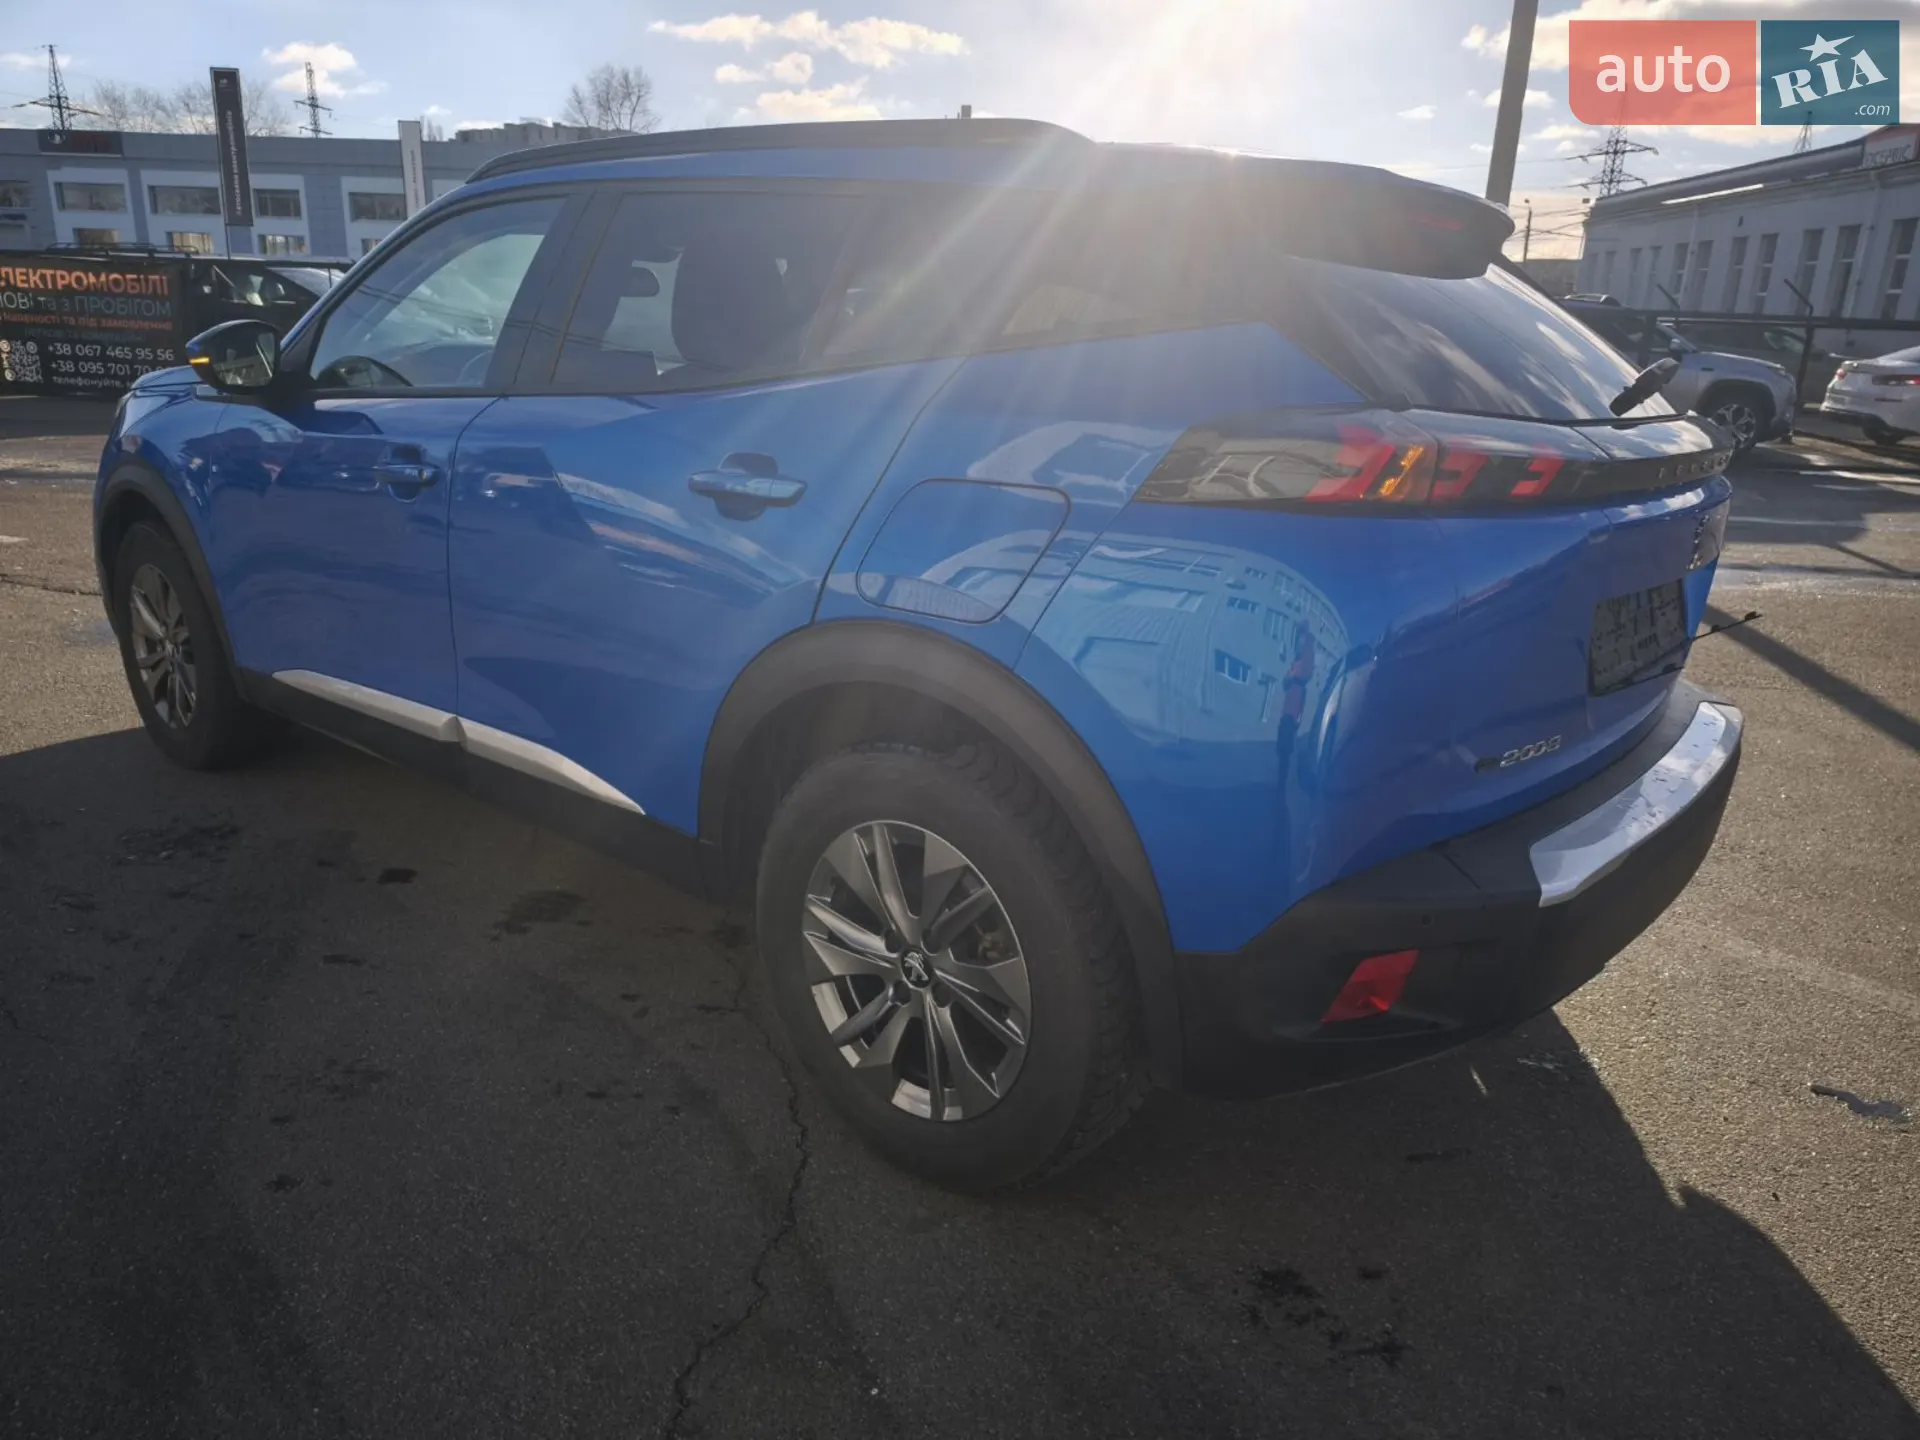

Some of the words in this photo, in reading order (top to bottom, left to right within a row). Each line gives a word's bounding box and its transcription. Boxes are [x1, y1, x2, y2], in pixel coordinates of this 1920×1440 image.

[75, 295, 172, 317] ПРОБІГОМ
[48, 342, 72, 356] +38
[75, 344, 101, 357] 067
[106, 345, 133, 359] 465
[135, 347, 153, 360] 95
[157, 348, 175, 361] 56
[51, 359, 75, 373] +38
[79, 361, 105, 374] 095
[108, 362, 131, 376] 701
